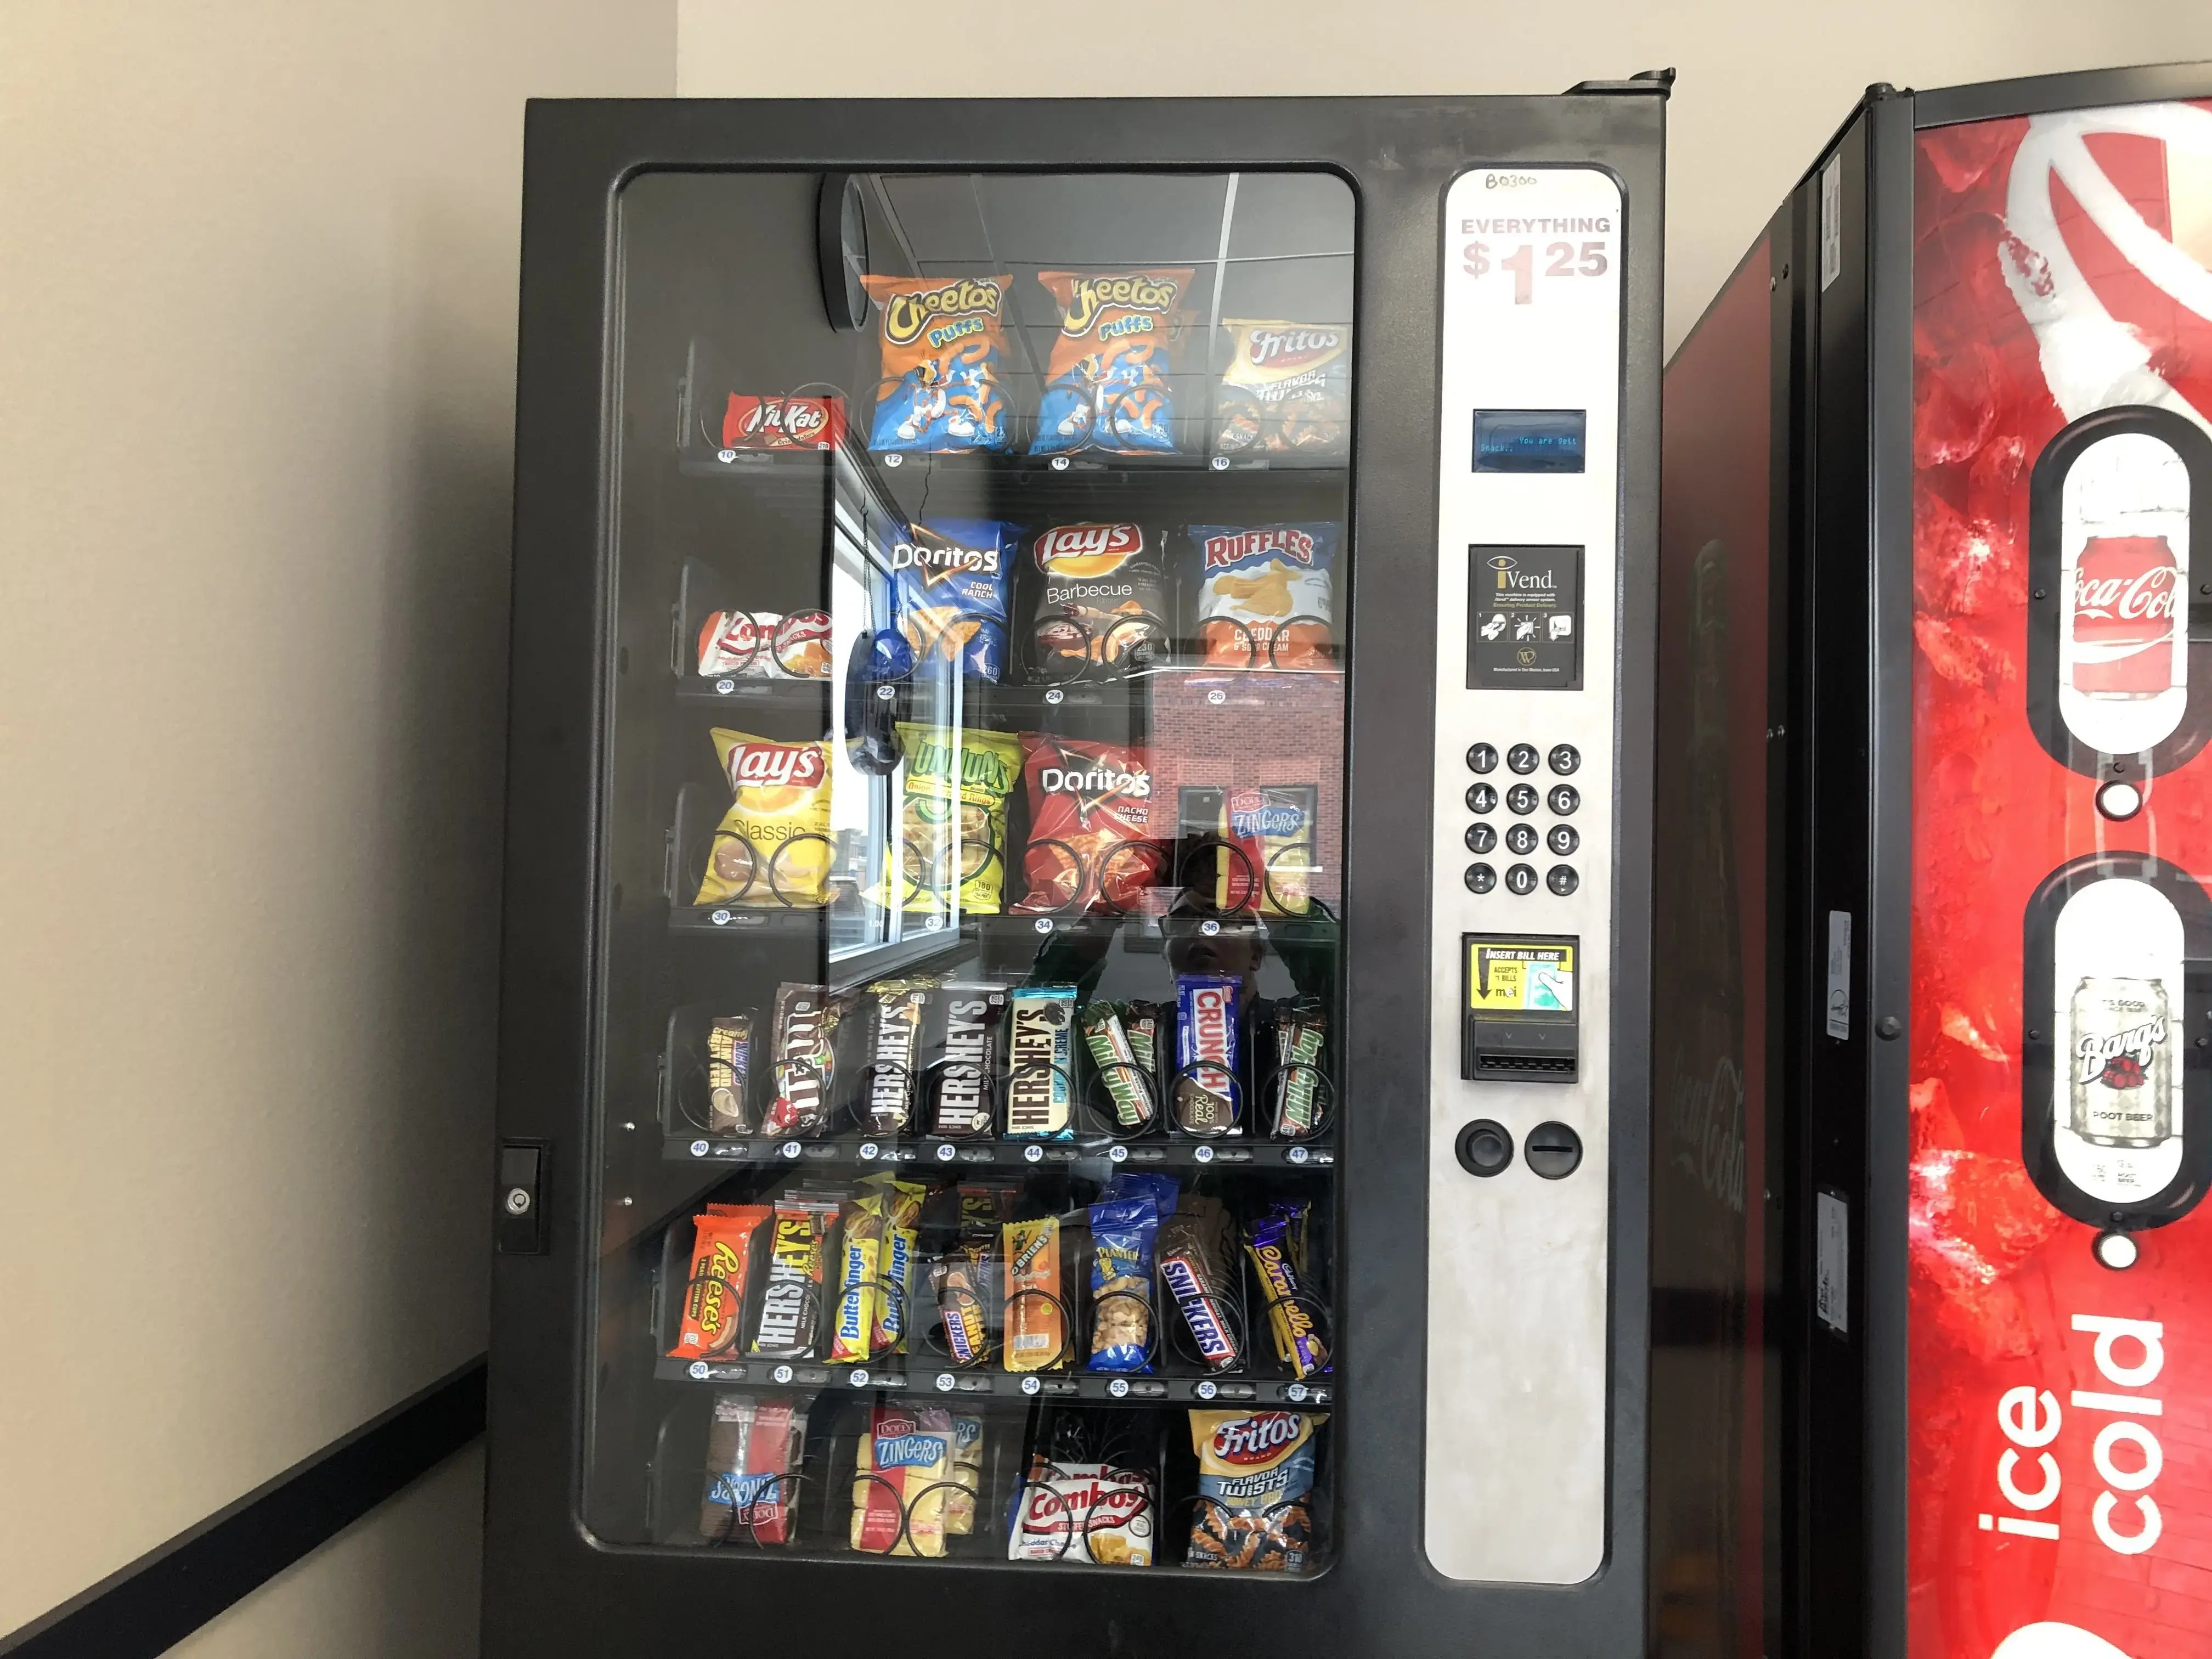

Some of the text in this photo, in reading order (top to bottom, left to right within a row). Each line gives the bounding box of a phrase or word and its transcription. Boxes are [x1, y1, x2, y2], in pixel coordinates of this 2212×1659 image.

[1462, 217, 1611, 234] EVERYTHING
[887, 279, 1000, 343] Cheetos
[927, 318, 984, 348] Puffs
[1098, 315, 1153, 341] Puffs
[1250, 329, 1339, 364] Fritos
[1519, 436, 1533, 444] You
[720, 450, 733, 459] 10
[1041, 524, 1132, 565] Lay's
[1205, 529, 1313, 569] RUFFLES
[893, 543, 998, 572] Doritos
[970, 581, 994, 591] COOL
[962, 588, 993, 599] RANCH
[1047, 583, 1132, 604] Barbecue
[719, 681, 732, 689] 20
[879, 687, 892, 696] 22
[1048, 691, 1062, 700] 24
[1210, 691, 1223, 700] 26
[1477, 750, 1486, 768] 1
[1518, 751, 1530, 768] 2
[1559, 751, 1572, 769] 3
[731, 743, 824, 790] Lay's
[1042, 767, 1150, 796] Doritos
[969, 793, 991, 805] Rings
[1475, 789, 1487, 808] 4
[1516, 791, 1528, 808] 5
[1558, 791, 1571, 810] 6
[1116, 805, 1149, 816] NACHO
[1477, 830, 1488, 847] 7
[1516, 830, 1528, 849] 8
[1557, 831, 1570, 850] 9
[1516, 871, 1527, 889] 0
[1559, 876, 1567, 885] #
[714, 912, 728, 921] 30
[927, 918, 941, 927] 32
[1037, 921, 1051, 930] 34
[1204, 923, 1217, 932] 36
[1485, 948, 1560, 961] INSERT BILL HERE
[1197, 991, 1227, 1089] CRUNCH
[2075, 1015, 2167, 1085] Barq's
[938, 1000, 988, 1125] HERSHEY'S
[1011, 1009, 1052, 1125] HERSHEY'S
[2125, 1113, 2153, 1121] BEER
[693, 1143, 706, 1152] 40
[785, 1144, 798, 1153] 41
[862, 1146, 876, 1155] 42
[939, 1148, 953, 1156] 43
[1026, 1148, 1040, 1157] 44
[1111, 1149, 1125, 1157] 45
[1197, 1149, 1211, 1158] 46
[1292, 1150, 1306, 1159] 47
[701, 1241, 739, 1335] Reese's
[758, 1221, 811, 1345] HERSHEY'S
[961, 1306, 982, 1353] EANUT
[692, 1365, 706, 1374] 50
[776, 1370, 790, 1379] 51
[853, 1373, 866, 1382] 52
[939, 1377, 952, 1386] 53
[1024, 1380, 1037, 1389] 54
[1112, 1383, 1126, 1392] 55
[1200, 1385, 1214, 1394] 56
[1290, 1387, 1304, 1397] 57
[881, 1423, 914, 1434] DOLLY
[2070, 1313, 2165, 1555] cold
[1214, 1414, 1301, 1457] Fritos
[1978, 1385, 2062, 1541] ice
[1232, 1467, 1279, 1486] FLAVOR
[1217, 1469, 1289, 1497] TWISTS
[1088, 1516, 1115, 1528] SNACKS
[1289, 1552, 1302, 1563] 310
